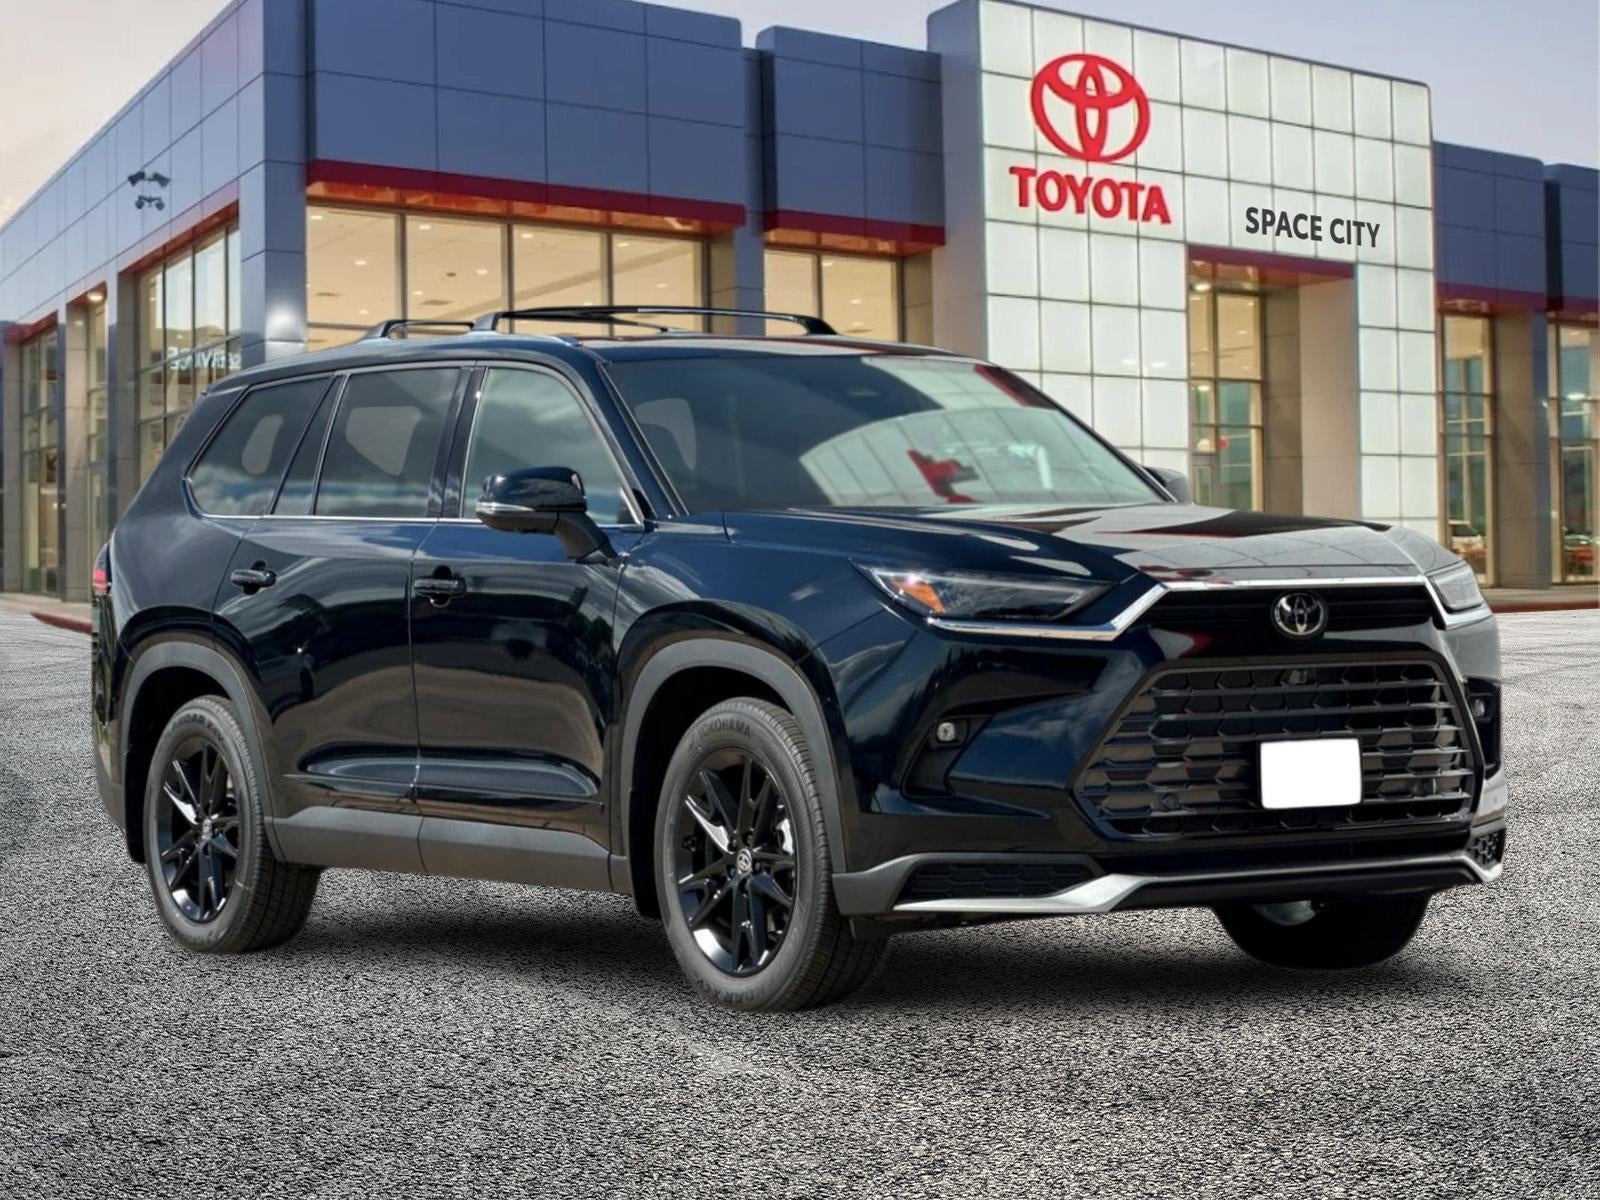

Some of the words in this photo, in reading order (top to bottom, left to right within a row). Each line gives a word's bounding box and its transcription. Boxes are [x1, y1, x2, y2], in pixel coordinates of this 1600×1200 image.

[1009, 166, 1171, 224] TOYOTA
[1246, 206, 1322, 241] SPACE
[1329, 218, 1380, 248] CITY
